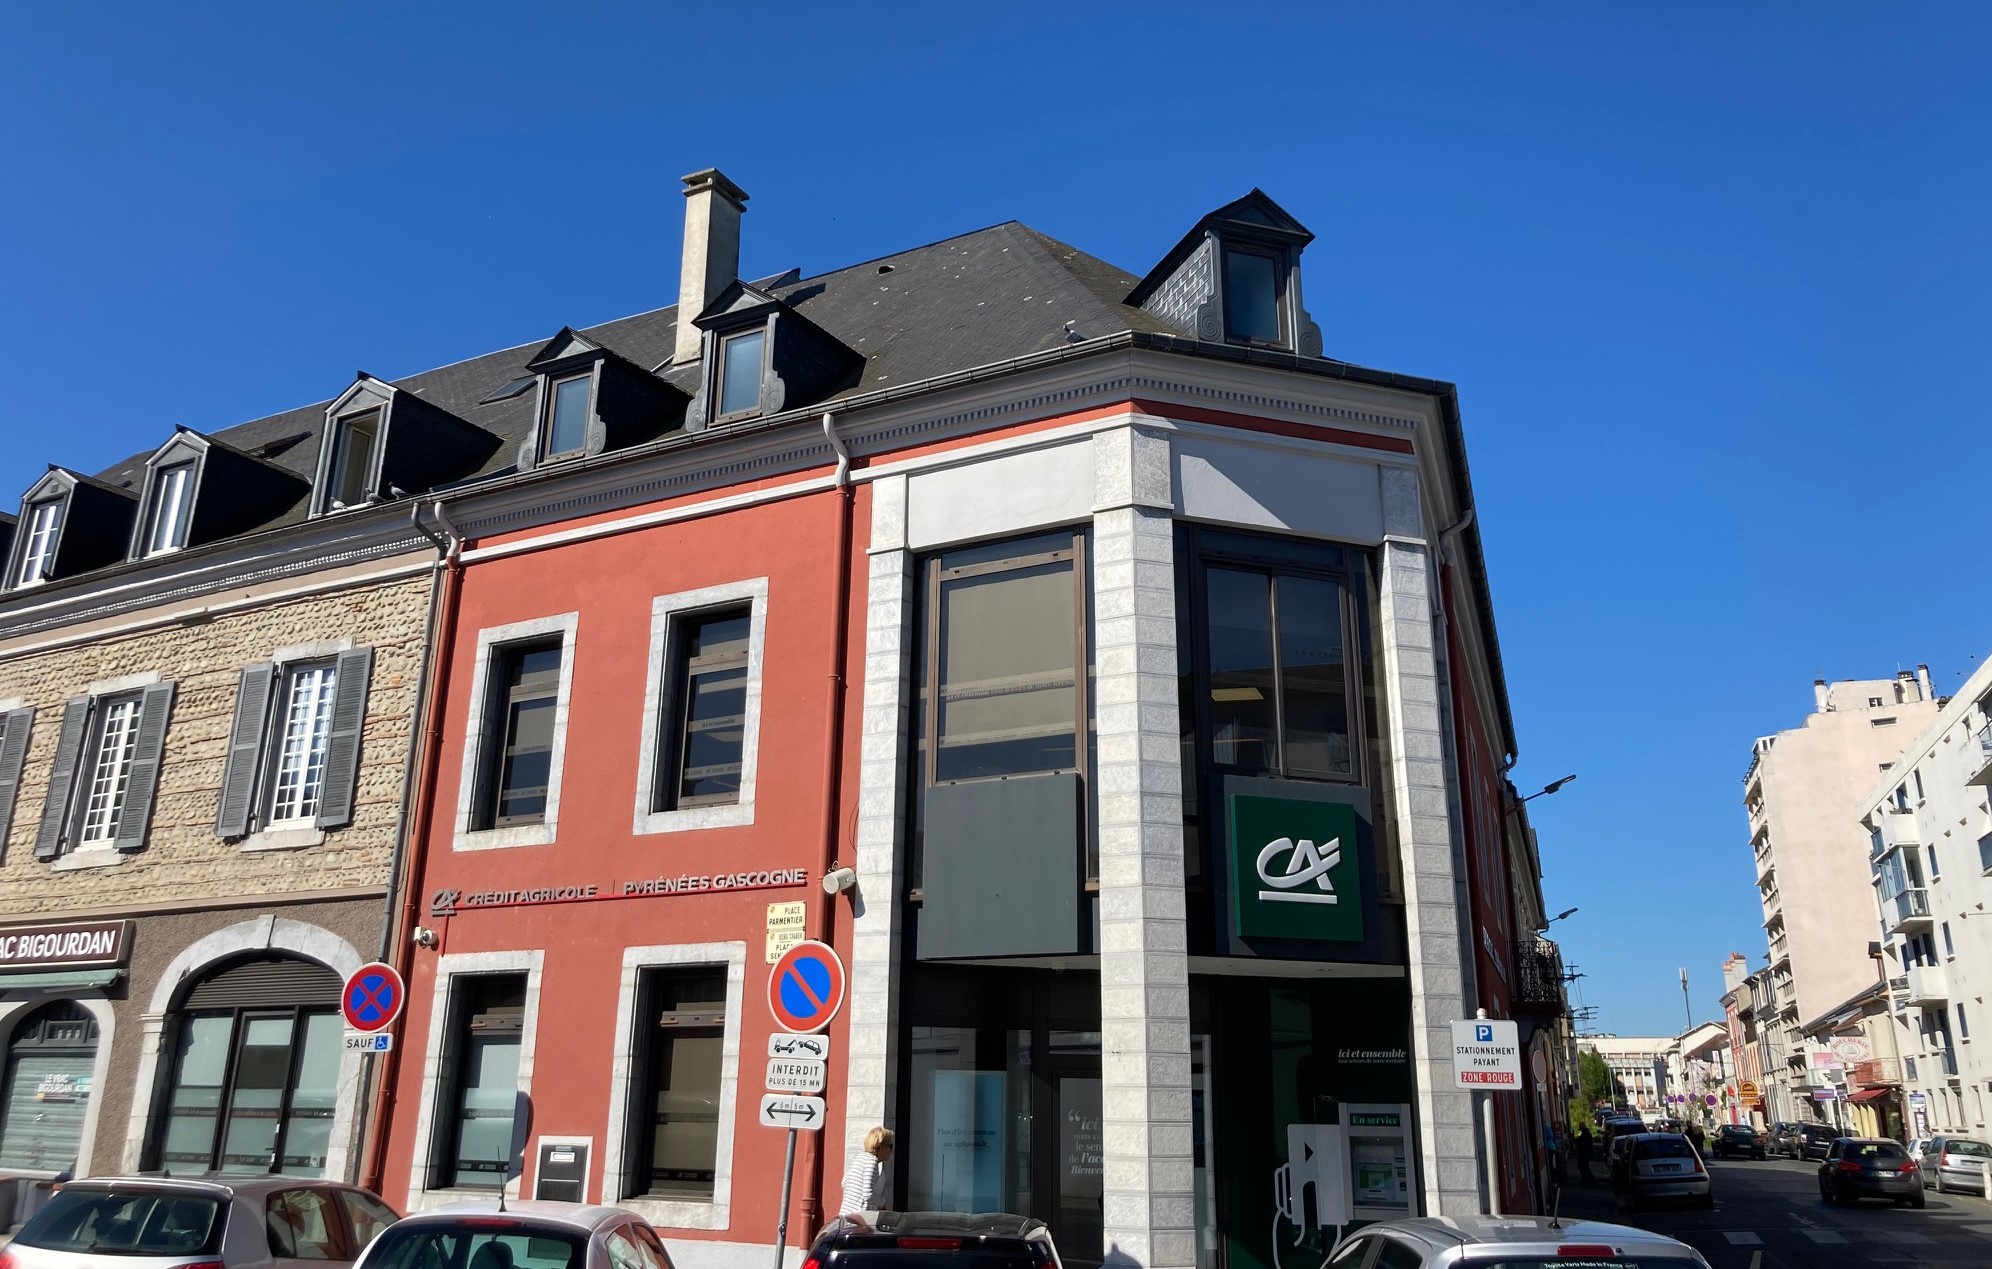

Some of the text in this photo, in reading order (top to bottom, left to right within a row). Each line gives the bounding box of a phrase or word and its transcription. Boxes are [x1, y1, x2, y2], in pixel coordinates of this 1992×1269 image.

[518, 884, 598, 903] AGRICOLE
[622, 873, 710, 895] PYRÉNÉES
[712, 868, 807, 889] GASCOGNE
[785, 906, 801, 915] PLACE
[769, 916, 803, 925] PARMENTIER
[17, 930, 116, 958] BIGOURDAN
[347, 1038, 374, 1048] SAUF
[1338, 1048, 1407, 1058] ici et ensemble
[1456, 1046, 1515, 1055] STATIONNEMENT
[1473, 1058, 1500, 1066] PAYANT
[773, 1065, 819, 1075] INTERDIT
[1462, 1072, 1514, 1083] ZONE ROUGE
[1352, 1115, 1398, 1124] En service
[1075, 1142, 1084, 1151] le
[1069, 1154, 1079, 1163] de
